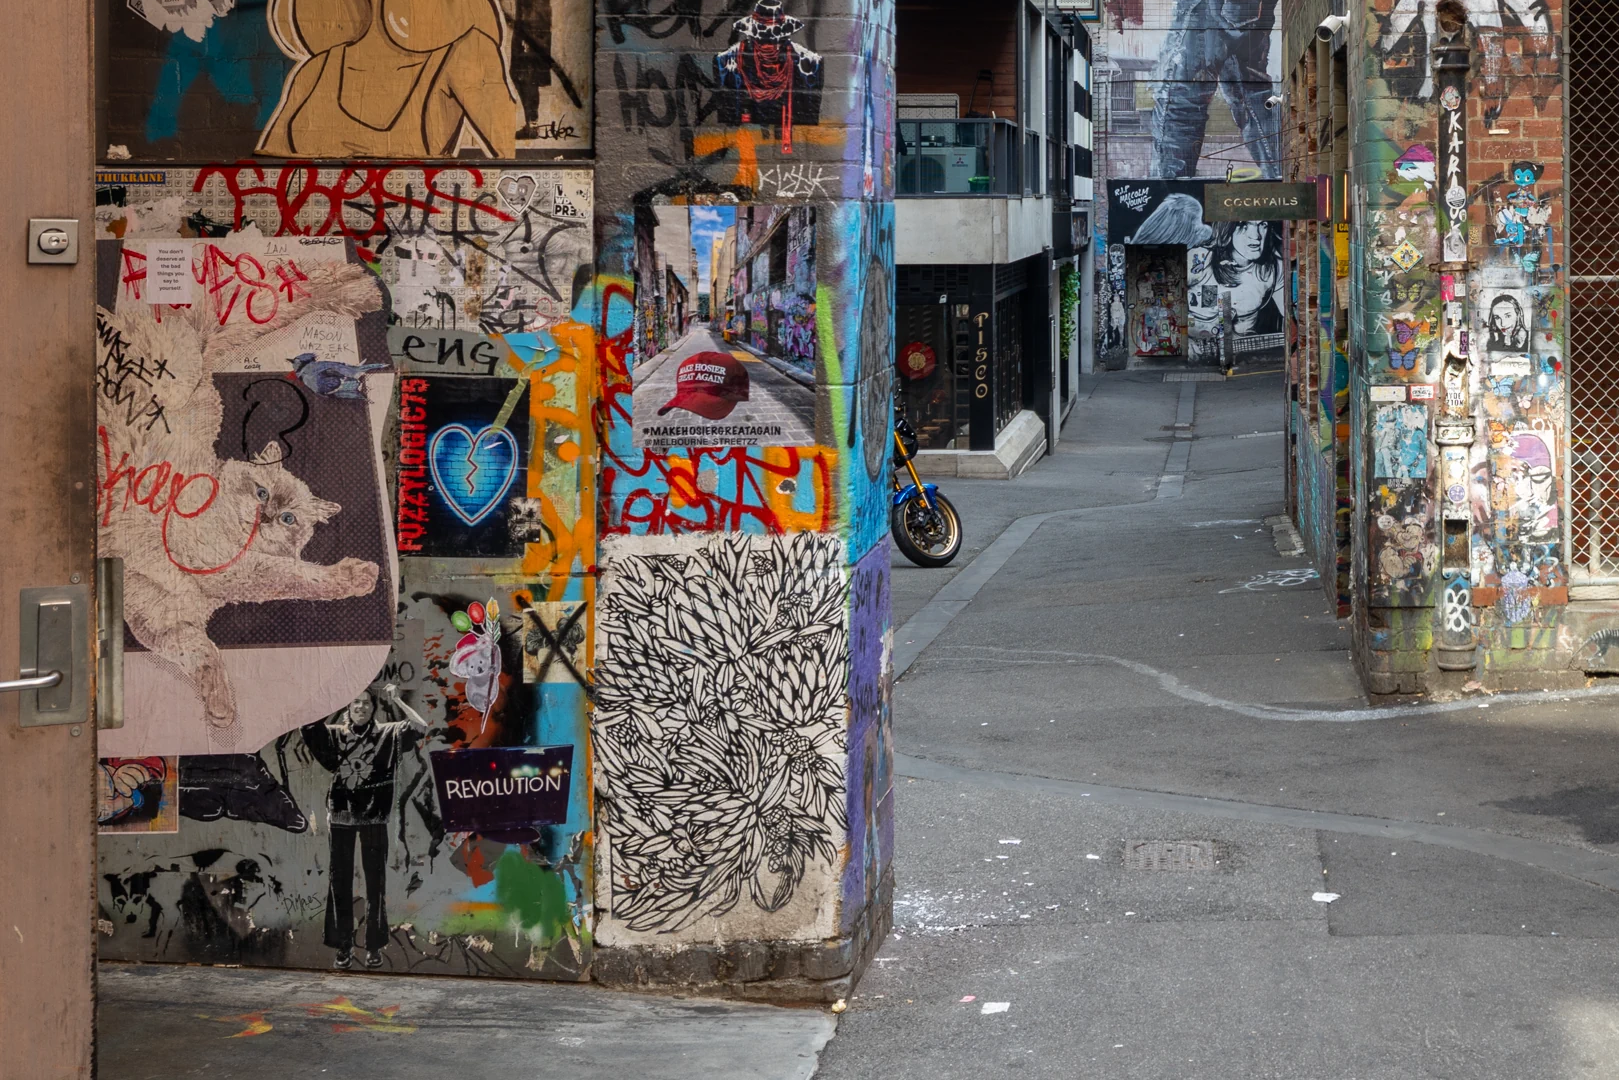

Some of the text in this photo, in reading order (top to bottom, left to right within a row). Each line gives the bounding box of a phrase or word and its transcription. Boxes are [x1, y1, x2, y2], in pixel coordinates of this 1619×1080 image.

[1223, 196, 1299, 208] COCKTAILS
[302, 327, 342, 341] MASON
[679, 363, 727, 376] MAKE HOSIER
[695, 373, 725, 384] AGAIN
[642, 426, 781, 436] #MAKEHOSIERGREATAGAIN
[446, 774, 561, 800] REVOLUTION
